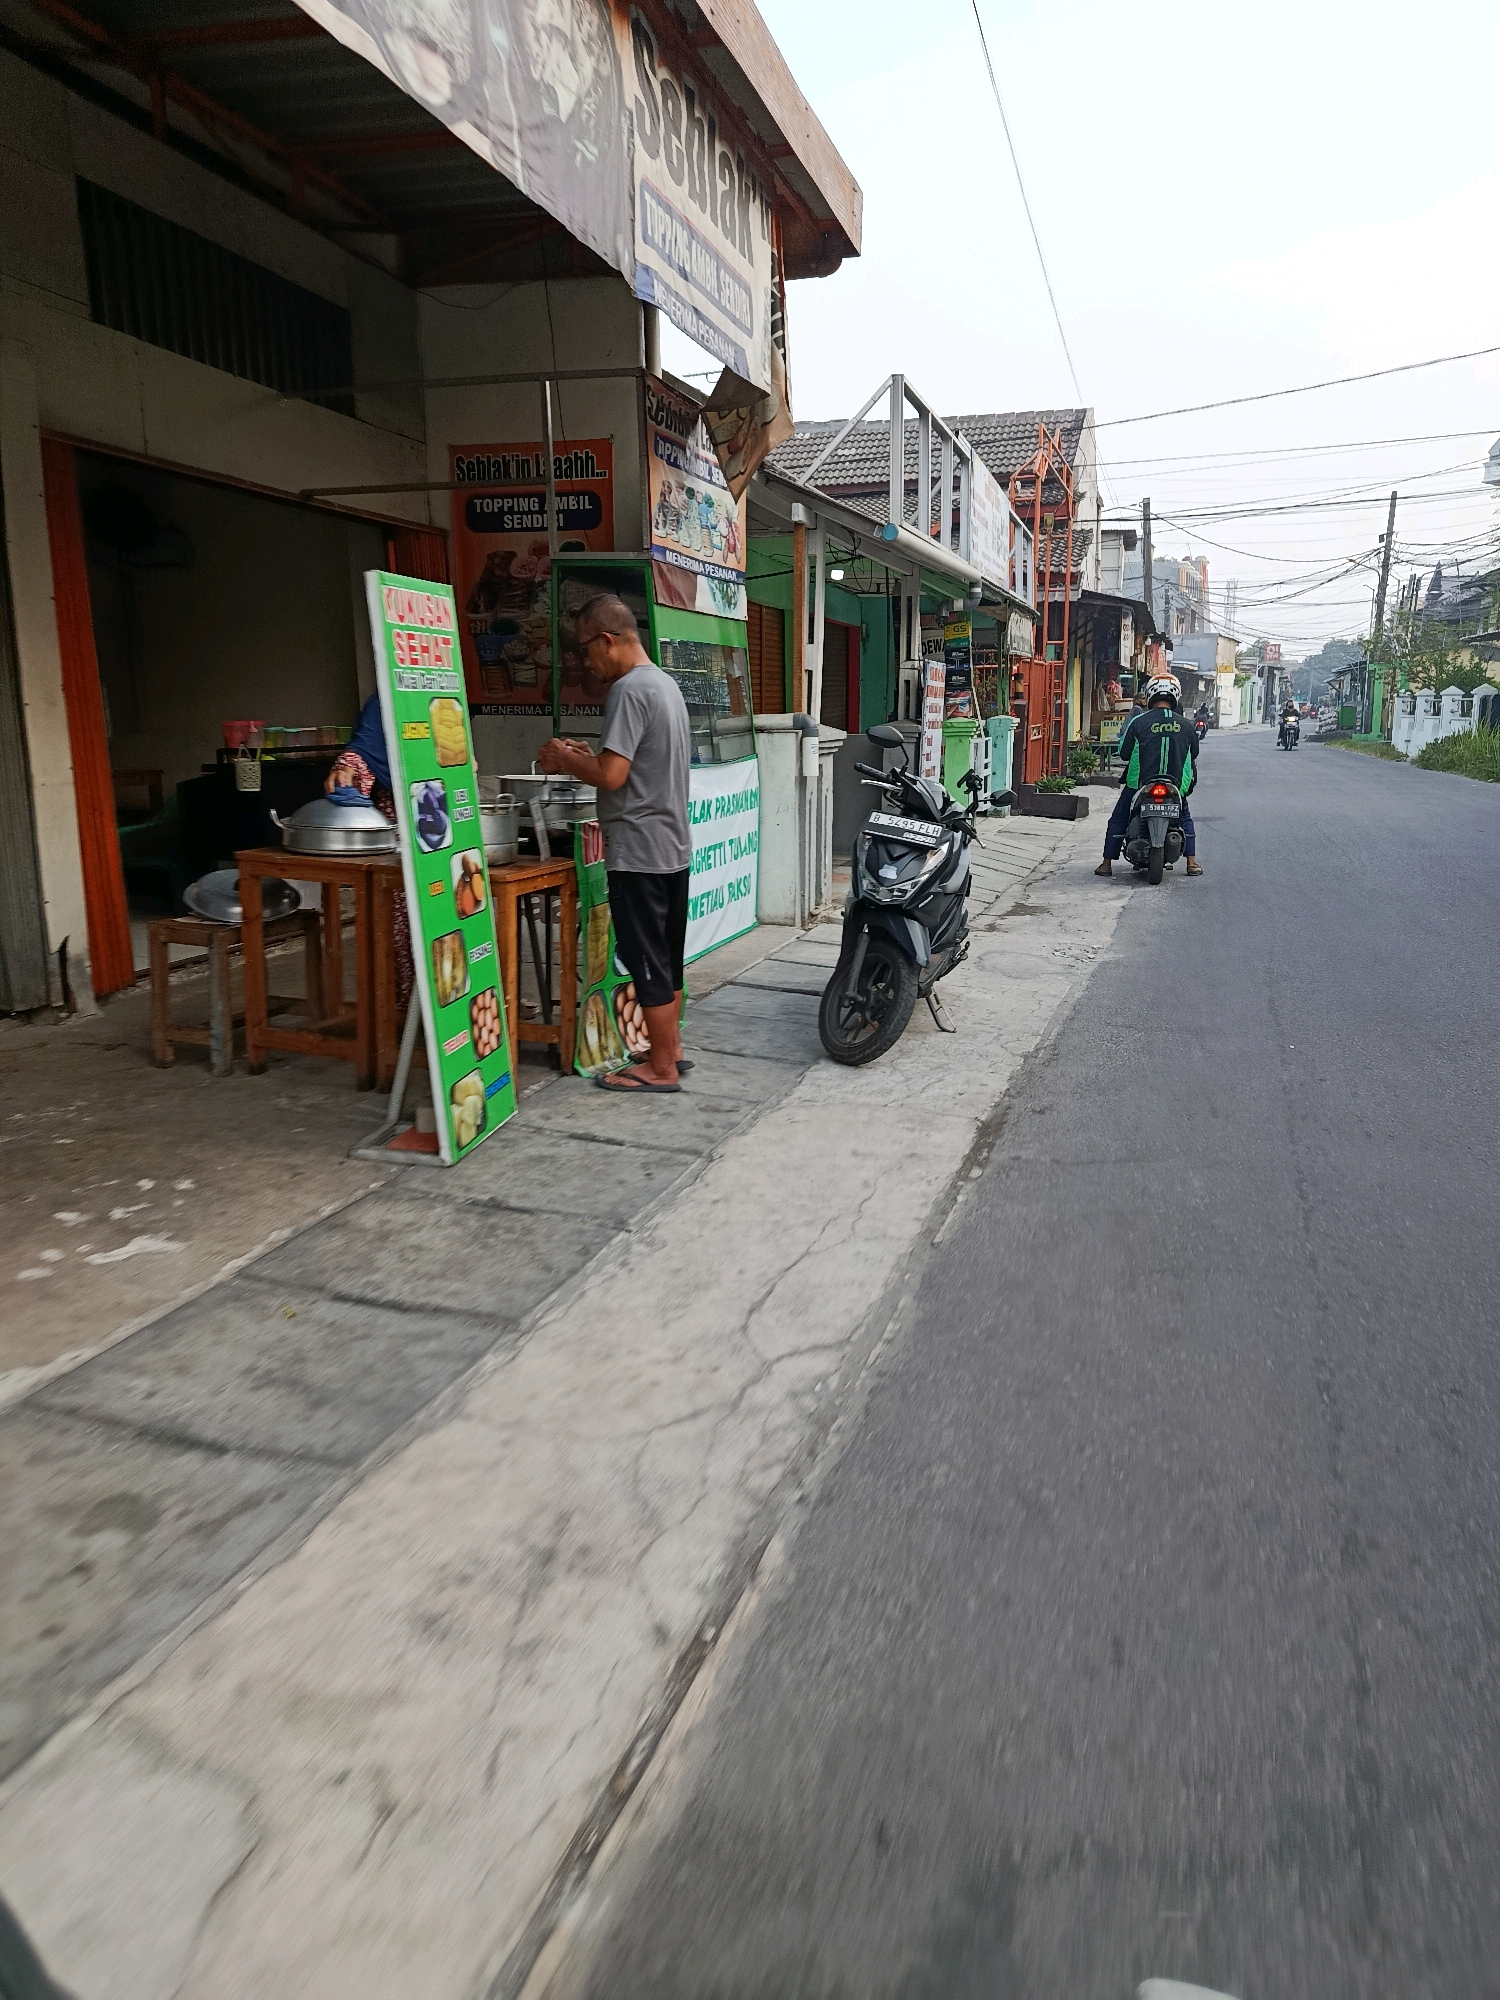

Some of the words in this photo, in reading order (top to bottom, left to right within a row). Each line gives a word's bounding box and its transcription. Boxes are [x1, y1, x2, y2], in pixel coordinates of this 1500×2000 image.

[644, 191, 690, 274] TOPPING
[690, 236, 720, 301] AMBIL
[719, 267, 751, 329] SENDIRI
[654, 278, 699, 338] MENERIMA
[698, 320, 735, 367] PESANAN
[455, 453, 532, 482] Seblak'in
[533, 450, 608, 480] Laahh...
[474, 497, 540, 513] TOPPING
[503, 513, 564, 529] SENDII
[665, 550, 705, 574] MENERIMA
[705, 564, 738, 582] PESANAN
[382, 585, 455, 632] KUKUSAN
[953, 624, 967, 632] GS
[392, 628, 454, 670] SEHAT
[922, 639, 945, 656] DEW
[482, 705, 543, 715] MENERIMA
[545, 706, 600, 716] PSANAN
[1150, 720, 1181, 733] Grab
[688, 798, 713, 824] BLAK
[874, 813, 881, 823] B
[918, 824, 941, 836] FLH
[689, 840, 726, 876] AGHETTI
